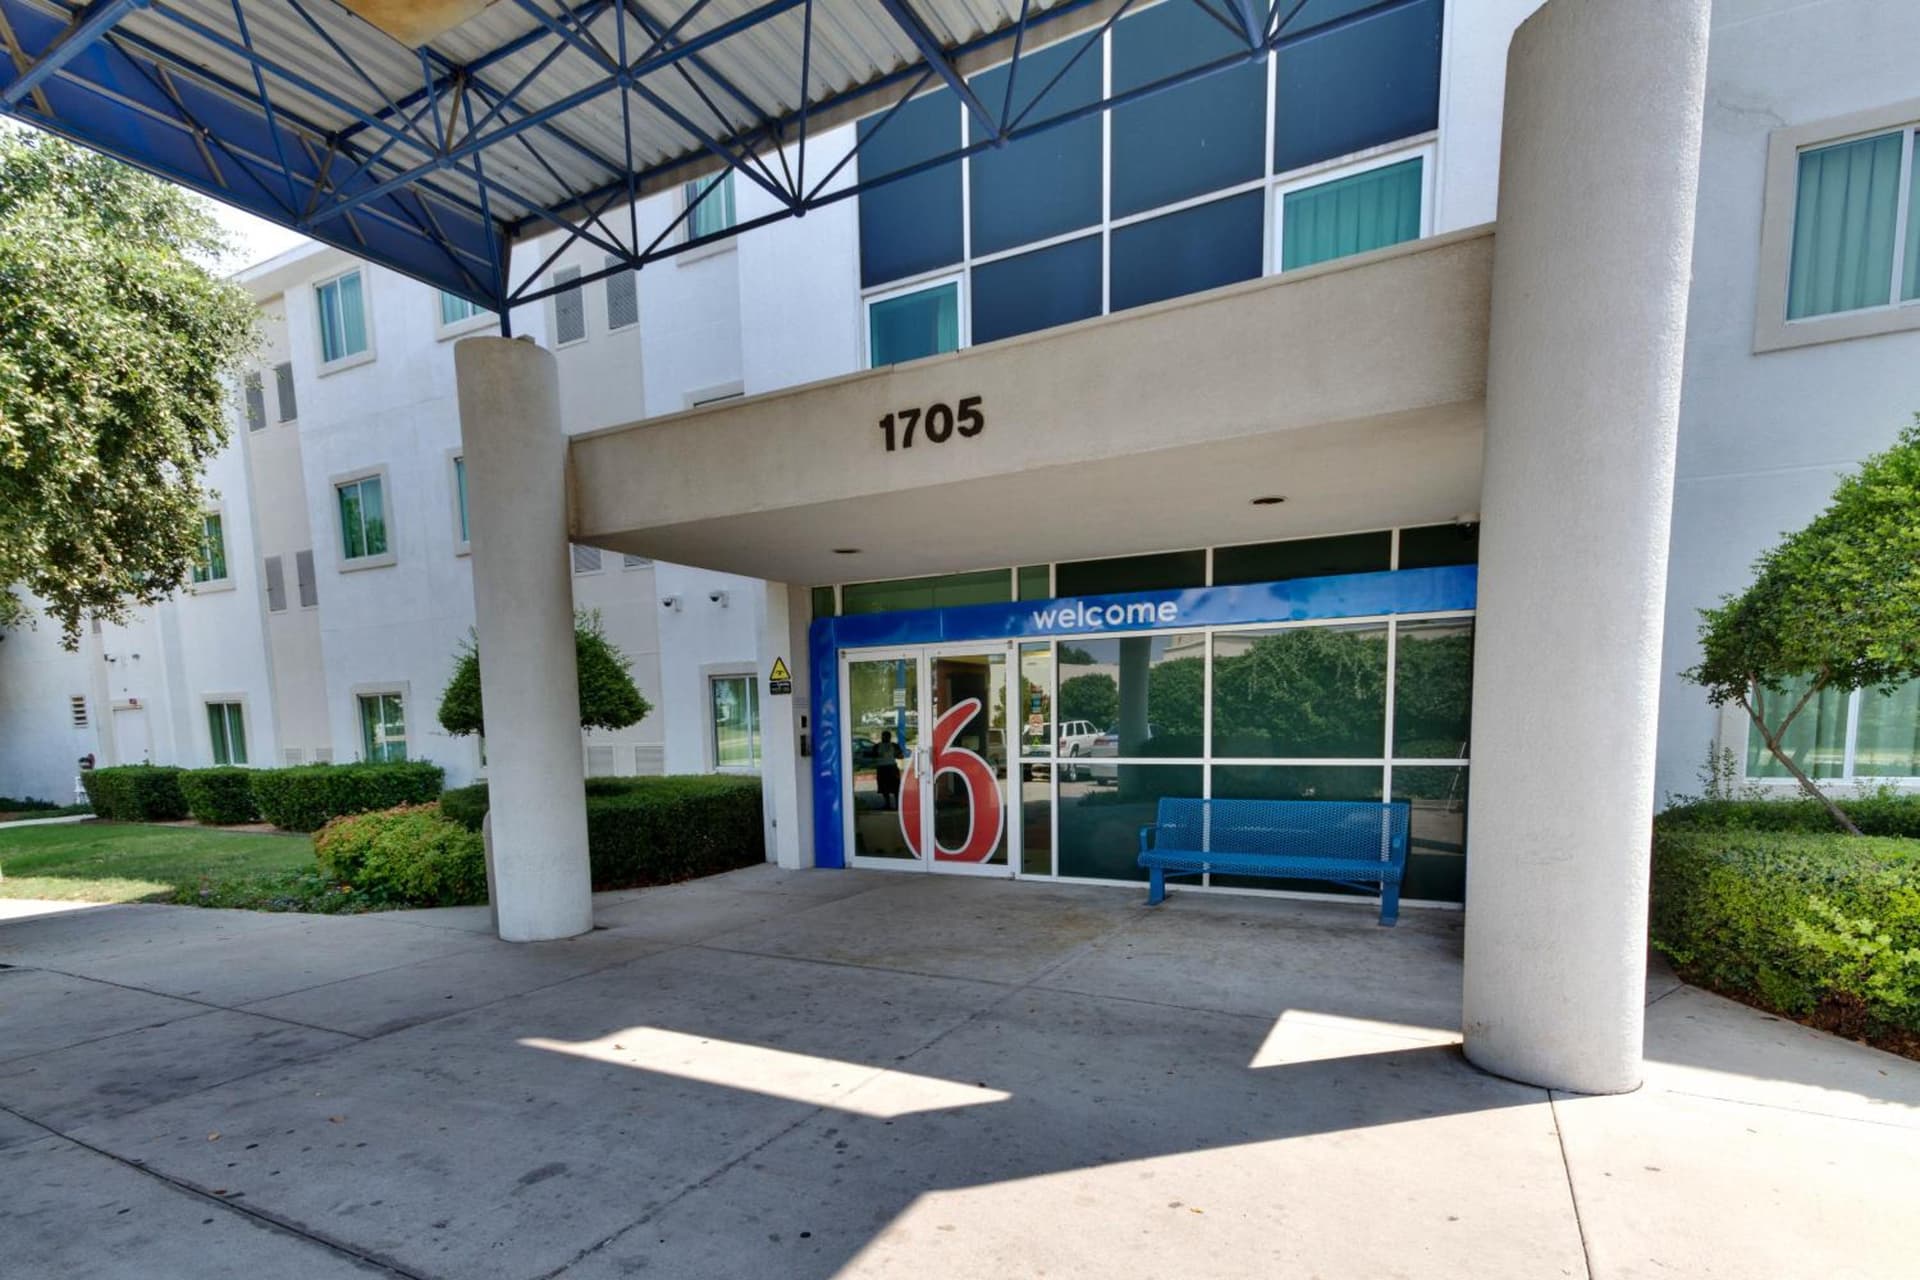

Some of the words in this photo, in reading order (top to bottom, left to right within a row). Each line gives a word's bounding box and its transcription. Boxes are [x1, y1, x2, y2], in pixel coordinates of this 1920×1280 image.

[879, 395, 984, 452] 1705
[1033, 600, 1178, 630] welcome
[898, 697, 1005, 864] 6
